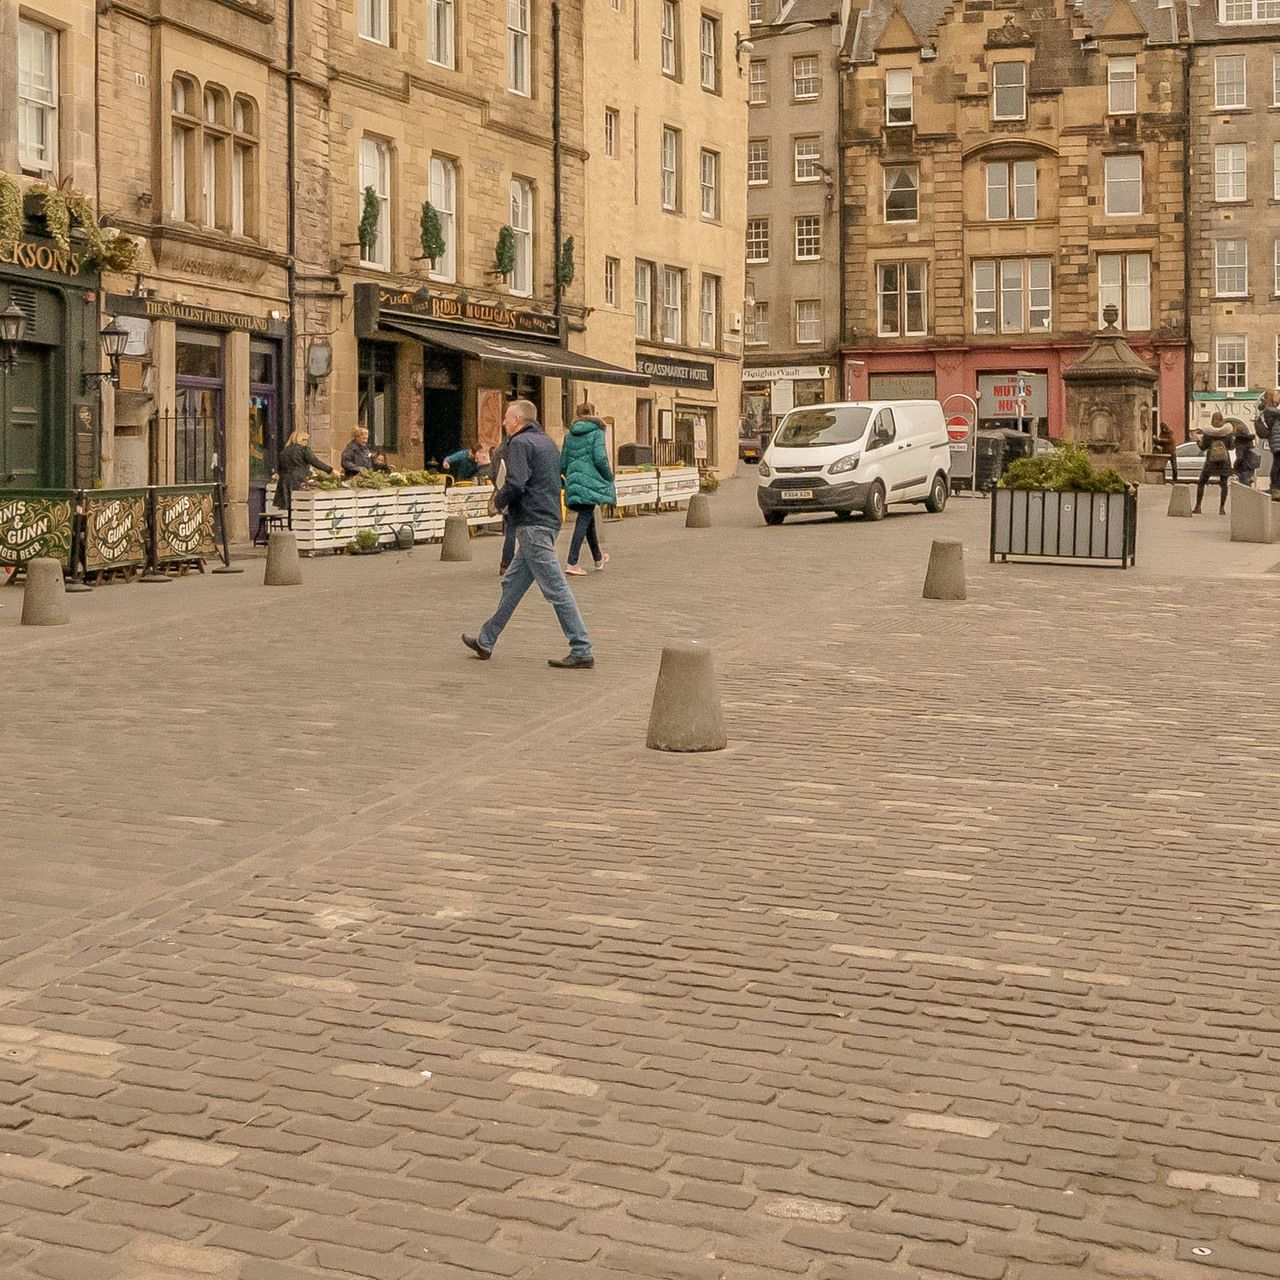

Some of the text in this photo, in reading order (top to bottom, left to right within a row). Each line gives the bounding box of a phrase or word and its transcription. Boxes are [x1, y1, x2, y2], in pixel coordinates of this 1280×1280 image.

[146, 301, 161, 315] THE
[163, 303, 204, 321] SMALLEST
[205, 310, 220, 324] PUB
[229, 314, 268, 330] SCOTLAND
[432, 297, 462, 318] BIDDY
[644, 362, 689, 379] GRASSMARKET
[689, 368, 708, 381] HOTEL
[993, 385, 1032, 396] MUTS
[96, 500, 120, 529] INNIS
[165, 496, 190, 523] INNIS
[182, 509, 190, 523] &
[7, 517, 48, 545] GUNN
[13, 516, 24, 530] &
[107, 514, 132, 545] GUNN
[111, 515, 120, 528] &
[178, 509, 203, 537] GUNN
[19, 544, 42, 560] BEER
[98, 539, 128, 559] LAGER BEER
[168, 533, 201, 552] LAGER BEER
